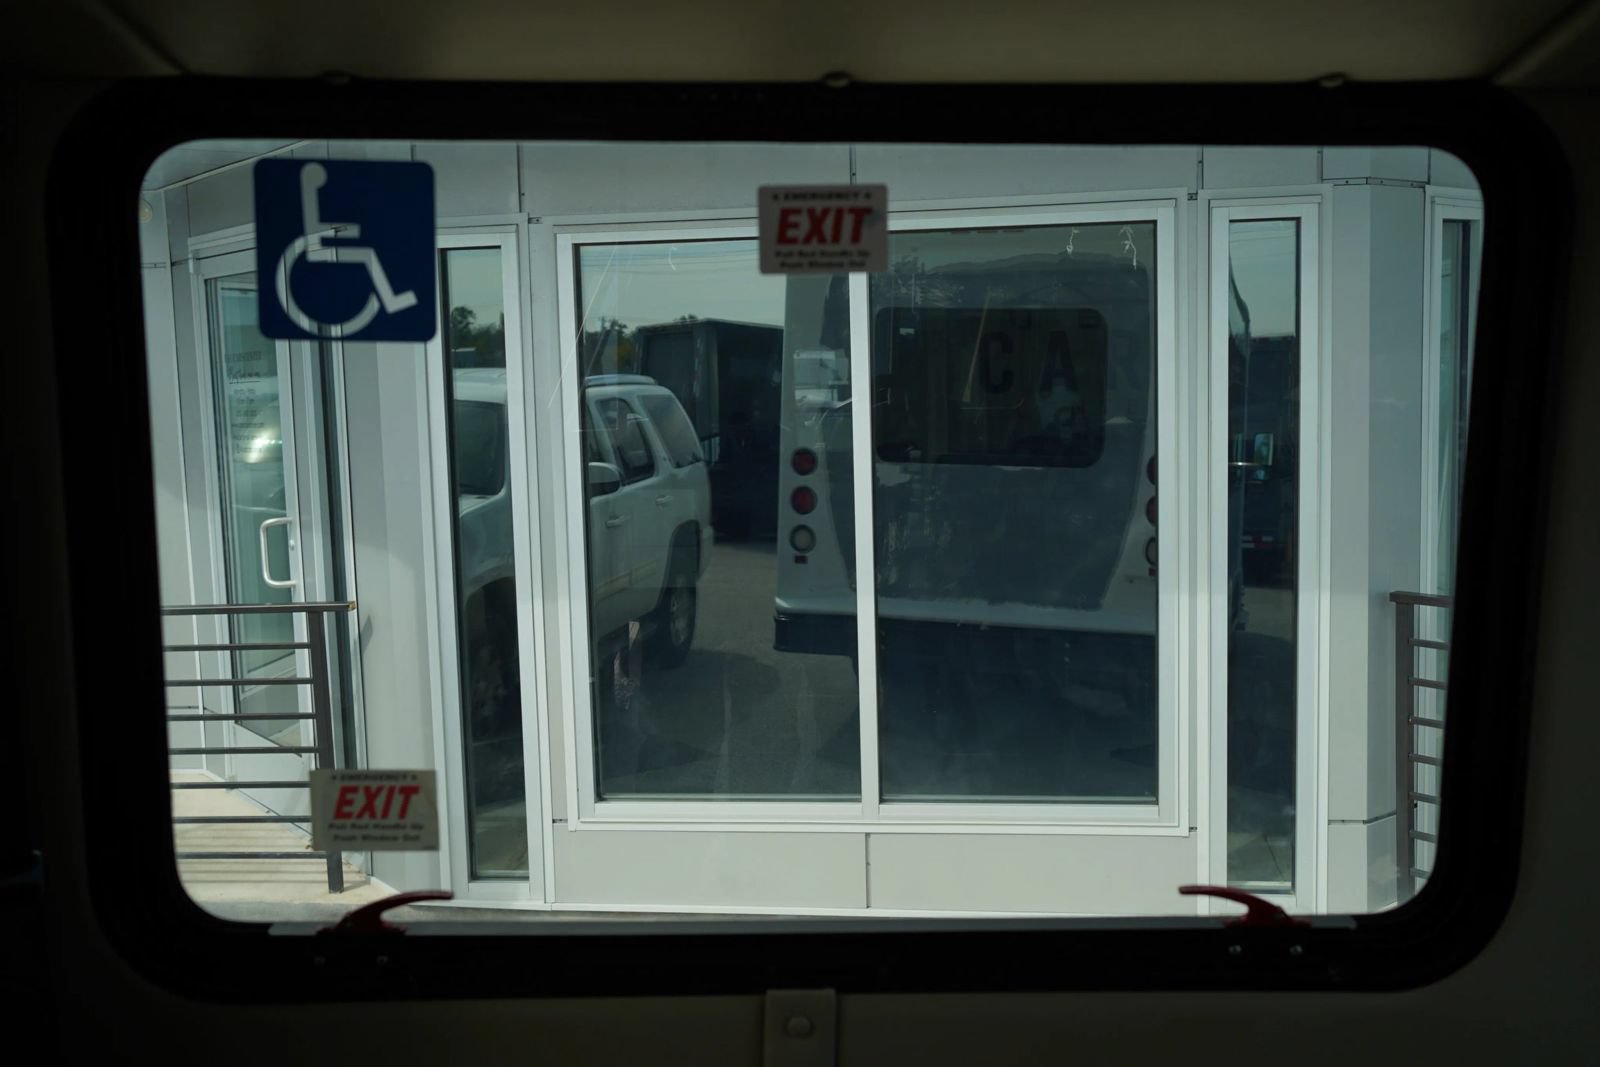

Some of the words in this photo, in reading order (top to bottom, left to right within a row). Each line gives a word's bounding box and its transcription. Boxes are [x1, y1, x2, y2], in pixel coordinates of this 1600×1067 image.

[784, 191, 860, 201] EMERGENCY
[776, 206, 873, 245] EXIT
[334, 785, 420, 820] EXIT
